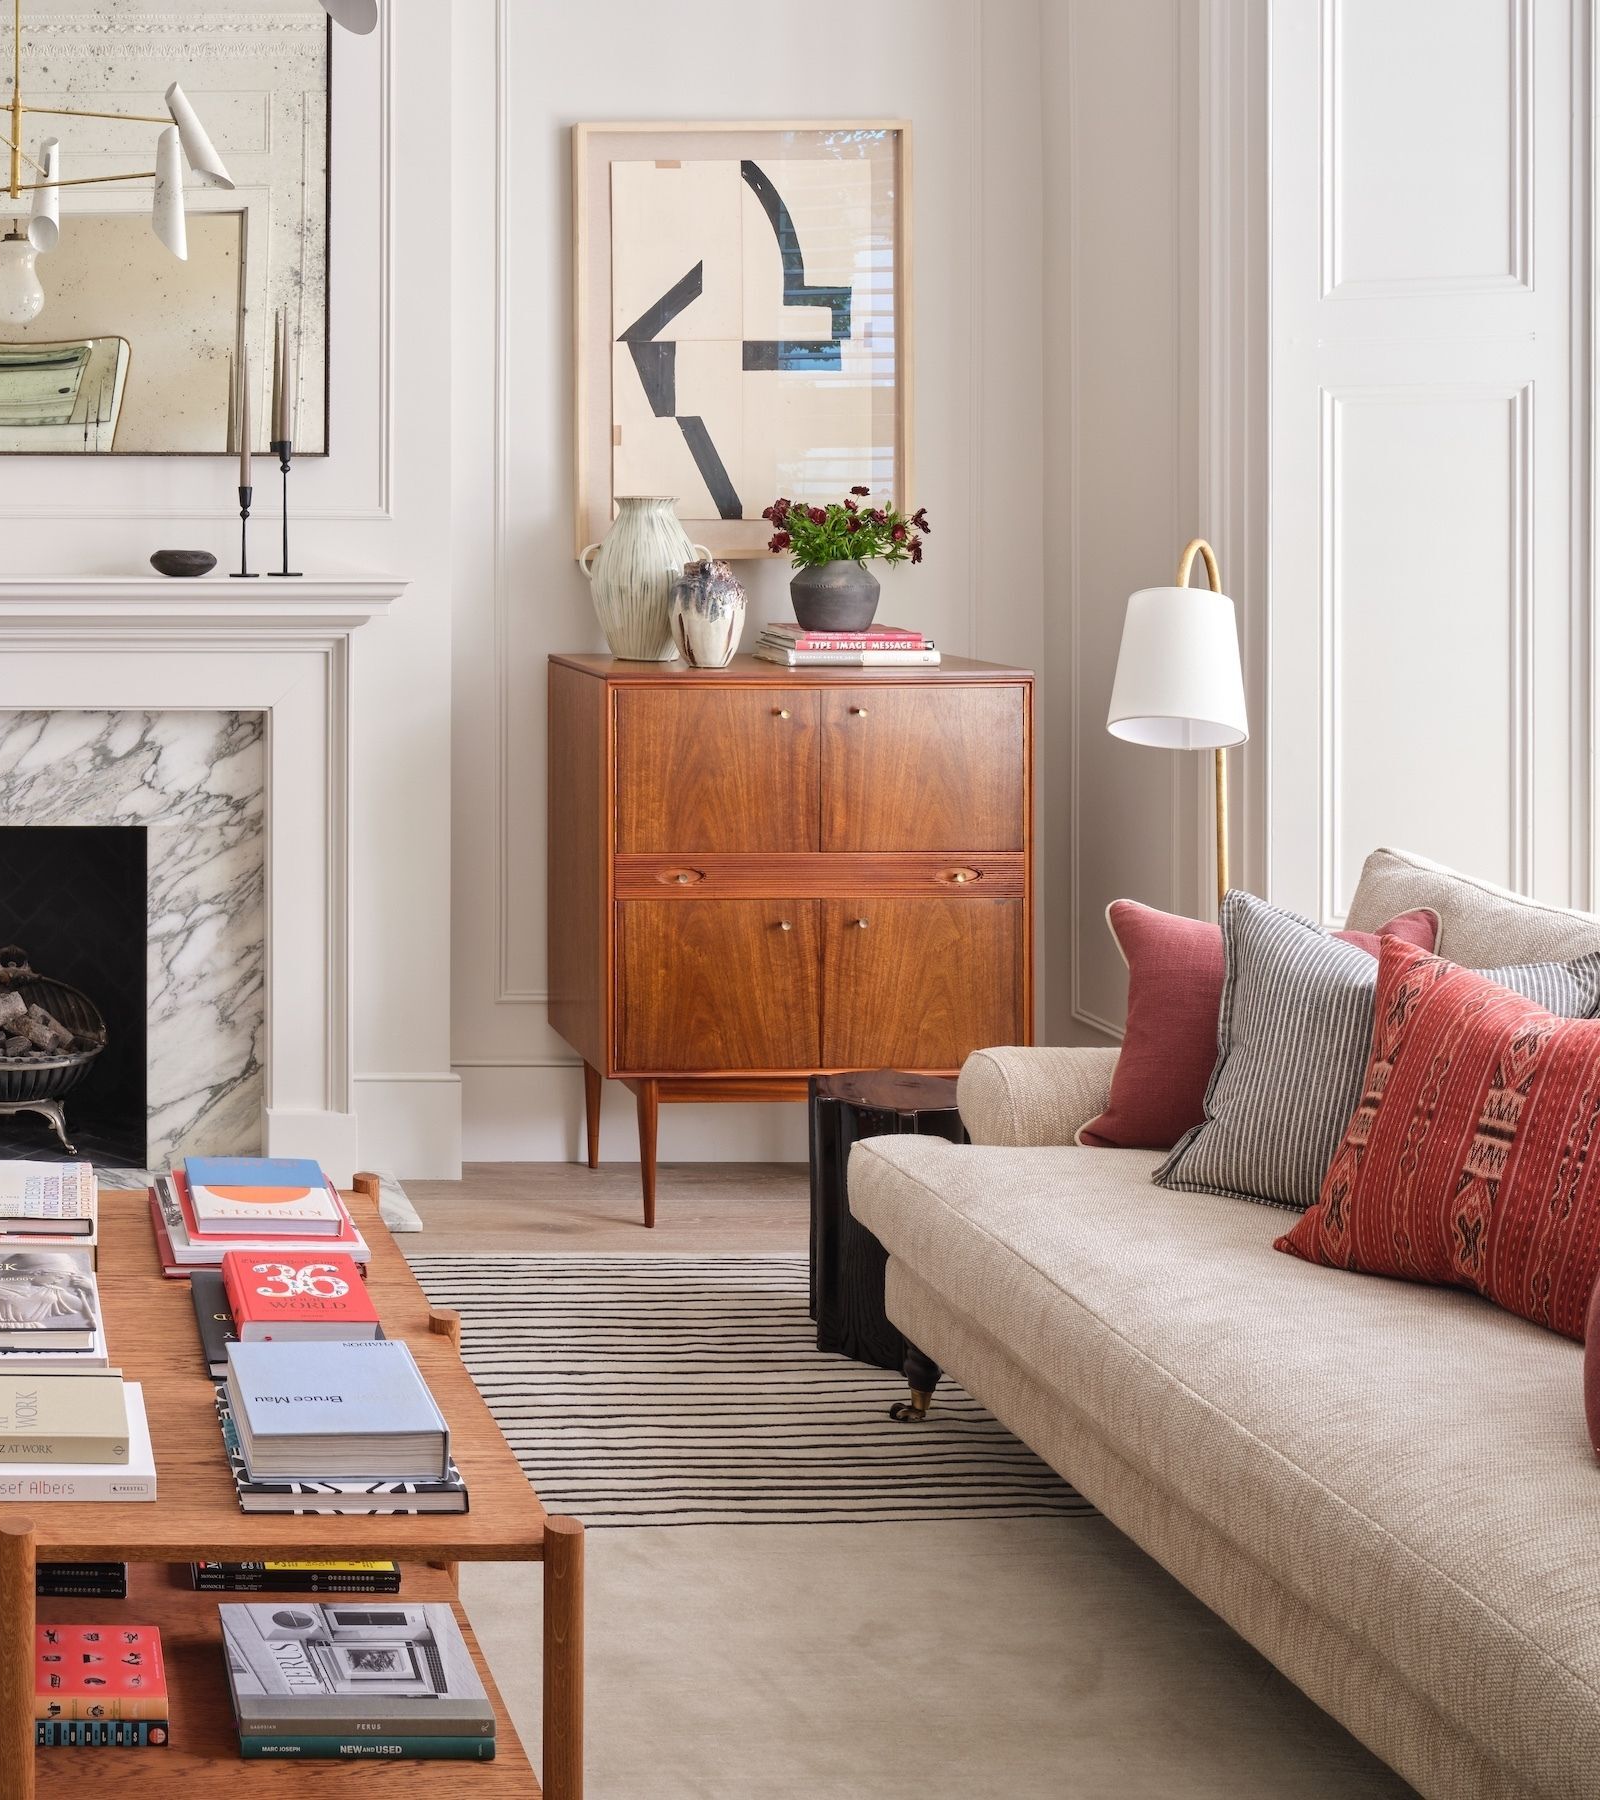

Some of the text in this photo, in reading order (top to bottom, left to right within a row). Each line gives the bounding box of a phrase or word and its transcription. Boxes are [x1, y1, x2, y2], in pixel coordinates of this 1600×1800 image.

[808, 640, 832, 650] TYPE
[836, 640, 867, 650] IMAGE
[871, 640, 913, 650] MESSAGE
[212, 1208, 323, 1217] KINFOLK
[251, 1263, 350, 1298] 36
[254, 1395, 290, 1404] Mau
[293, 1395, 343, 1404] Bruce
[15, 1391, 38, 1428] WORK
[7, 1444, 20, 1453] AT
[22, 1444, 53, 1454] WORK
[29, 1480, 75, 1495] Albers
[269, 1641, 317, 1686] FERUS
